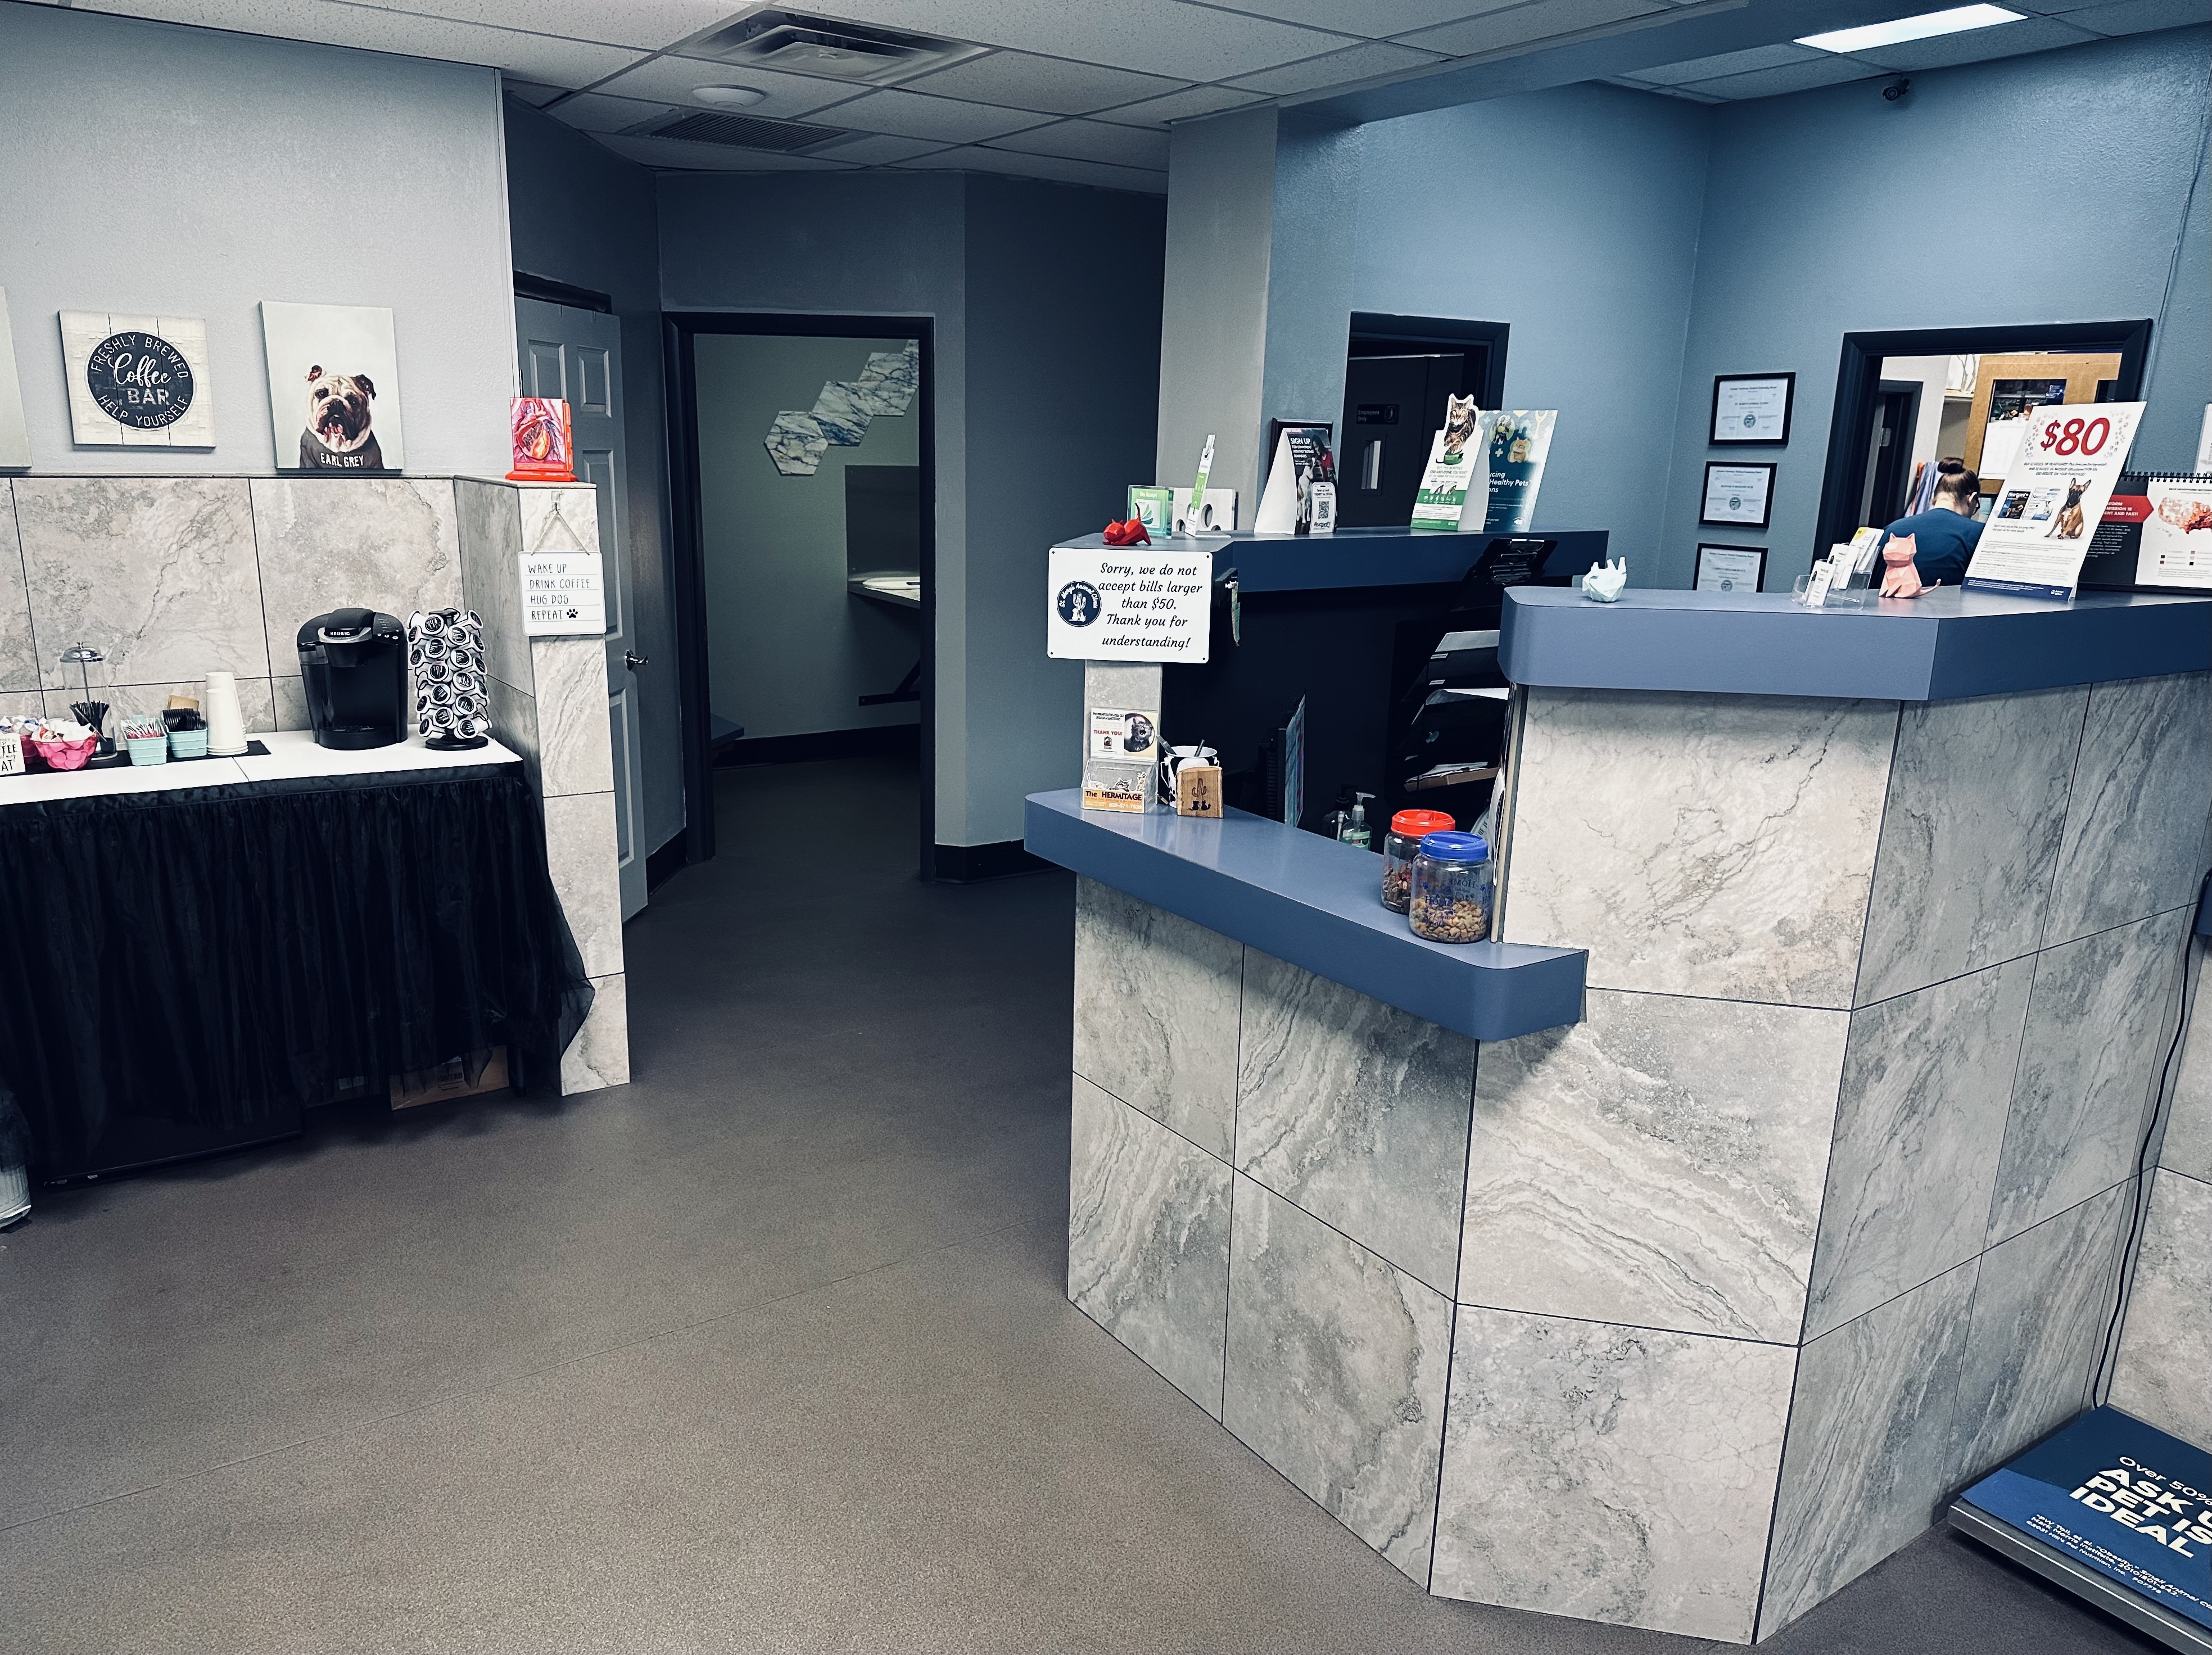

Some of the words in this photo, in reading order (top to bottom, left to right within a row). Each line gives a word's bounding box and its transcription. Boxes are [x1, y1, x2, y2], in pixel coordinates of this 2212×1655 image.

[91, 335, 135, 372] FRESHLY
[145, 337, 188, 378] BREWED
[107, 353, 171, 387] Coffee
[127, 388, 170, 405] BAR
[98, 395, 128, 419] HELP
[135, 396, 188, 427] YOURSELF
[2041, 418, 2110, 456] $80
[320, 453, 342, 467] EARL
[343, 455, 364, 467] GREY
[1489, 478, 1514, 487] Healthy
[528, 564, 553, 573] WAKE
[557, 563, 567, 573] UP
[1101, 563, 1134, 577] Sorry,
[1139, 567, 1155, 575] we
[1159, 563, 1173, 576] do
[1177, 566, 1197, 576] not
[530, 580, 556, 589] DRINK
[559, 578, 590, 589] COFFEE
[1098, 582, 1136, 594] accept
[1139, 580, 1163, 592] bills
[1167, 581, 1202, 596] larger
[531, 595, 547, 604] HUG
[551, 594, 568, 604] DOG
[1121, 597, 1147, 608] than
[1152, 596, 1177, 611] $50.
[532, 610, 563, 620] REPEAT
[1107, 613, 1141, 625] Thank
[1145, 618, 1166, 628] you
[1169, 615, 1188, 628] for
[1102, 635, 1191, 650] understanding!
[1101, 791, 1142, 801] HERMITAGE
[2119, 1457, 2166, 1481] Over
[2169, 1481, 2212, 1506] 50%
[2098, 1468, 2193, 1514] ASK
[2085, 1475, 2171, 1517] PET
[2172, 1518, 2212, 1545] IS
[2069, 1486, 2194, 1558] IDEAL
[2030, 1517, 2052, 1530] Mark
[2052, 1528, 2079, 1544] Morris
[2066, 1541, 2079, 1550] Pet
[2165, 1584, 2200, 1602] Animal
